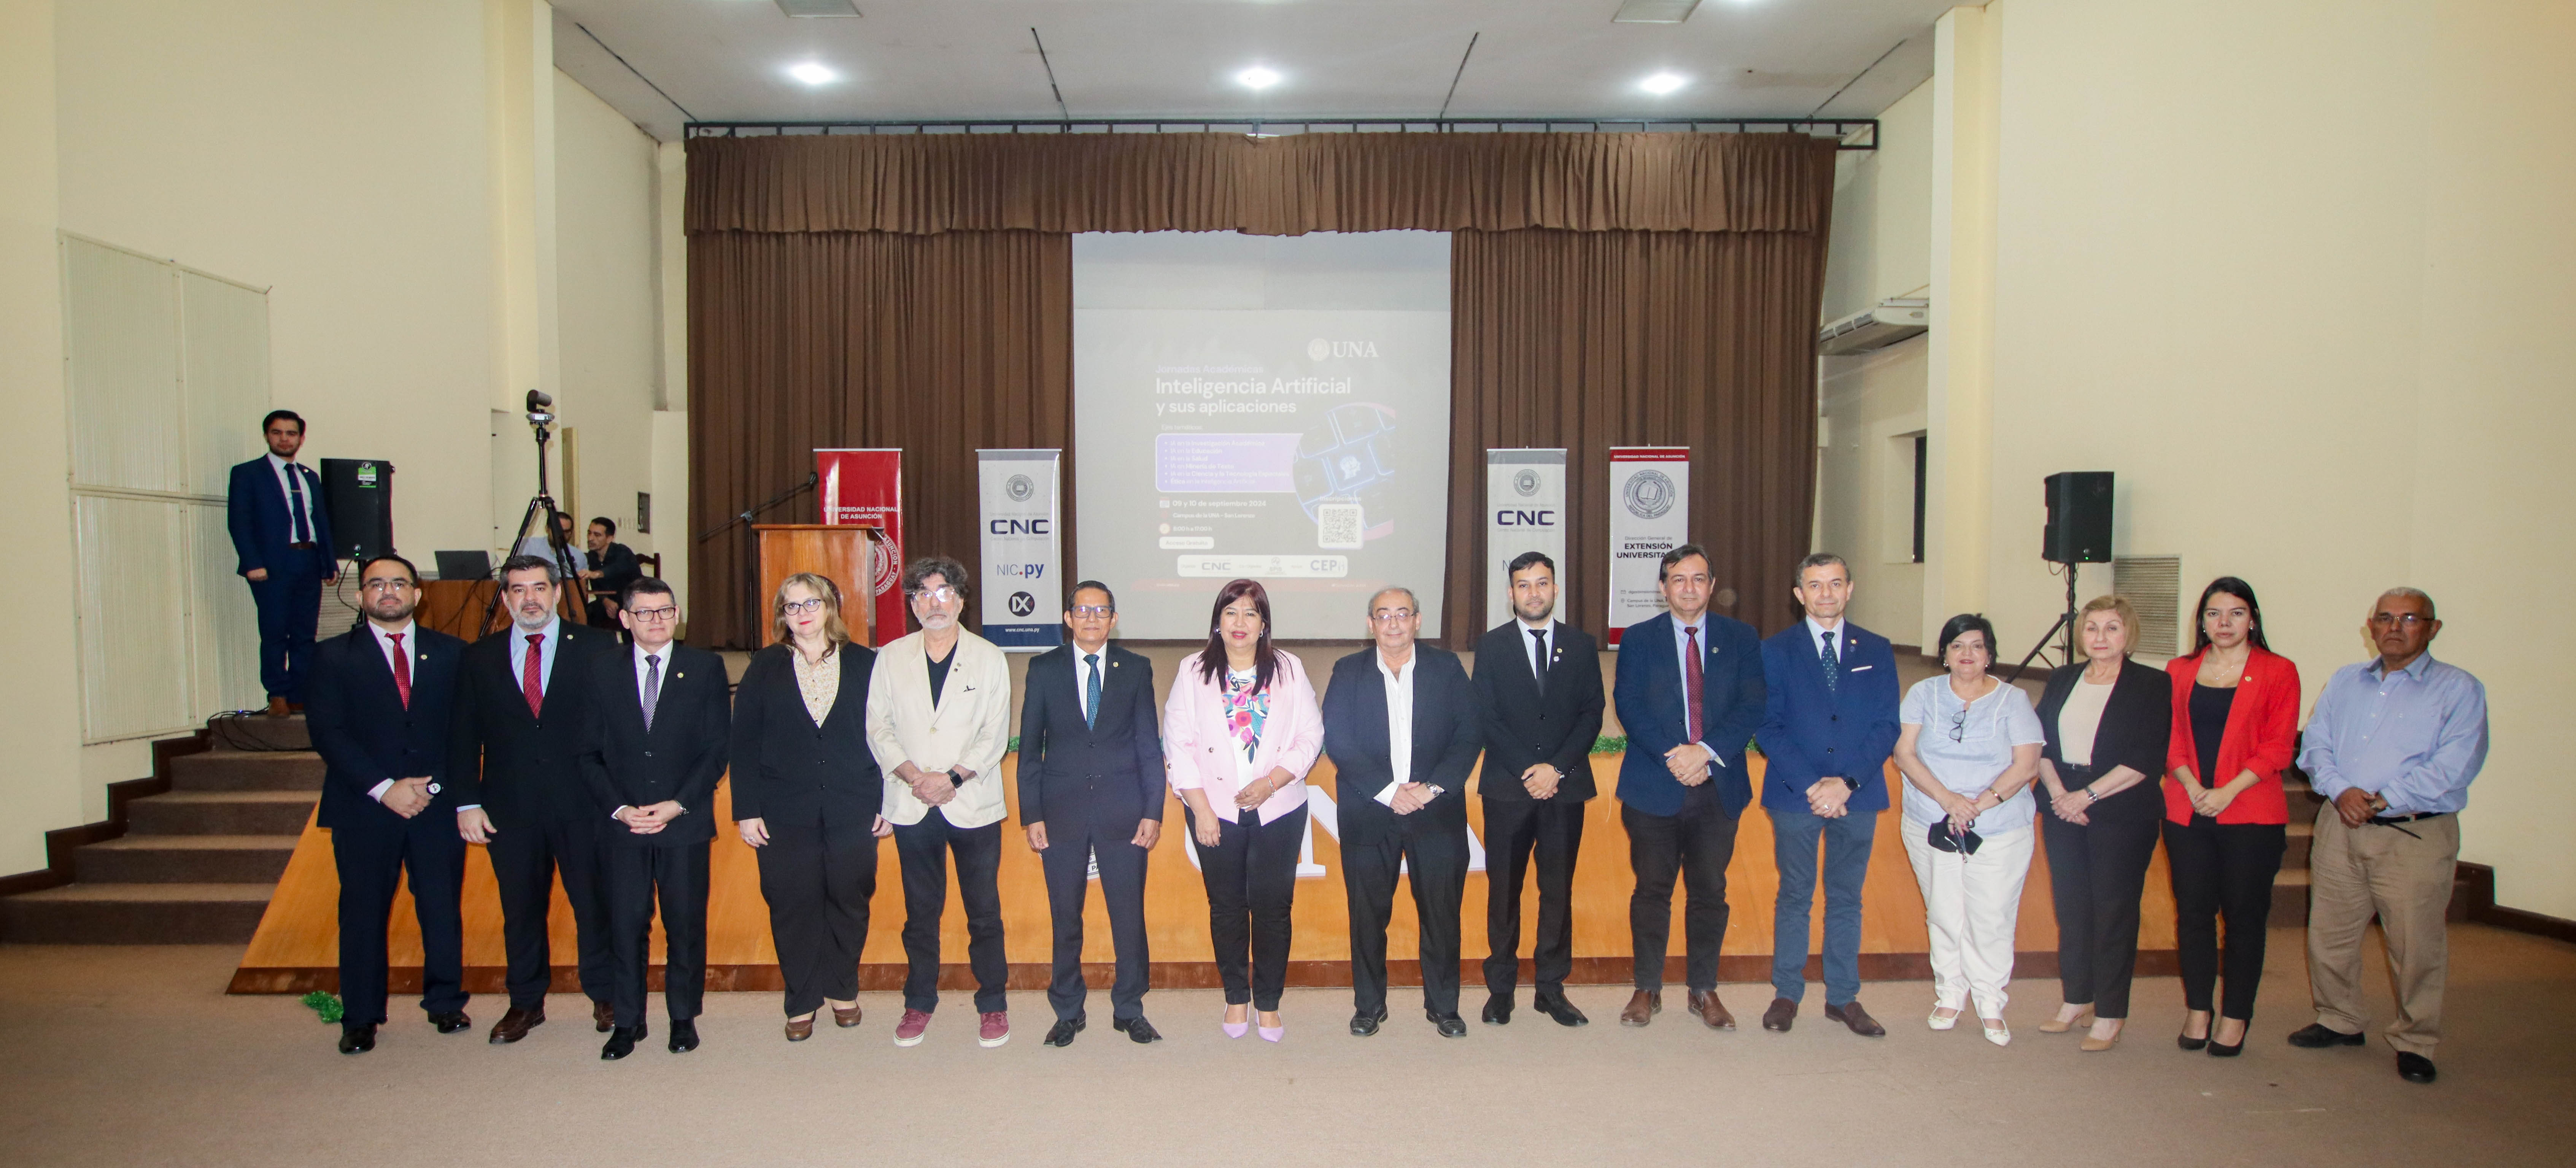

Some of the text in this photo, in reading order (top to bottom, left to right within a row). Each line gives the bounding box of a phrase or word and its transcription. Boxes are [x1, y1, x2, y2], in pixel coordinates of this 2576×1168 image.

[1333, 341, 1379, 357] UNA
[1155, 364, 1264, 374] Jornadas Académicas
[1156, 377, 1351, 398] Inteligencia Artificial
[1155, 400, 1297, 418] y sus aplicaciones
[1497, 510, 1555, 525] CNC
[1653, 505, 1670, 517] PARAGUAY
[990, 519, 1049, 535] CNC
[997, 563, 1044, 579] NIC.py
[1201, 562, 1231, 571] CNC
[1310, 559, 1337, 571] CEP
